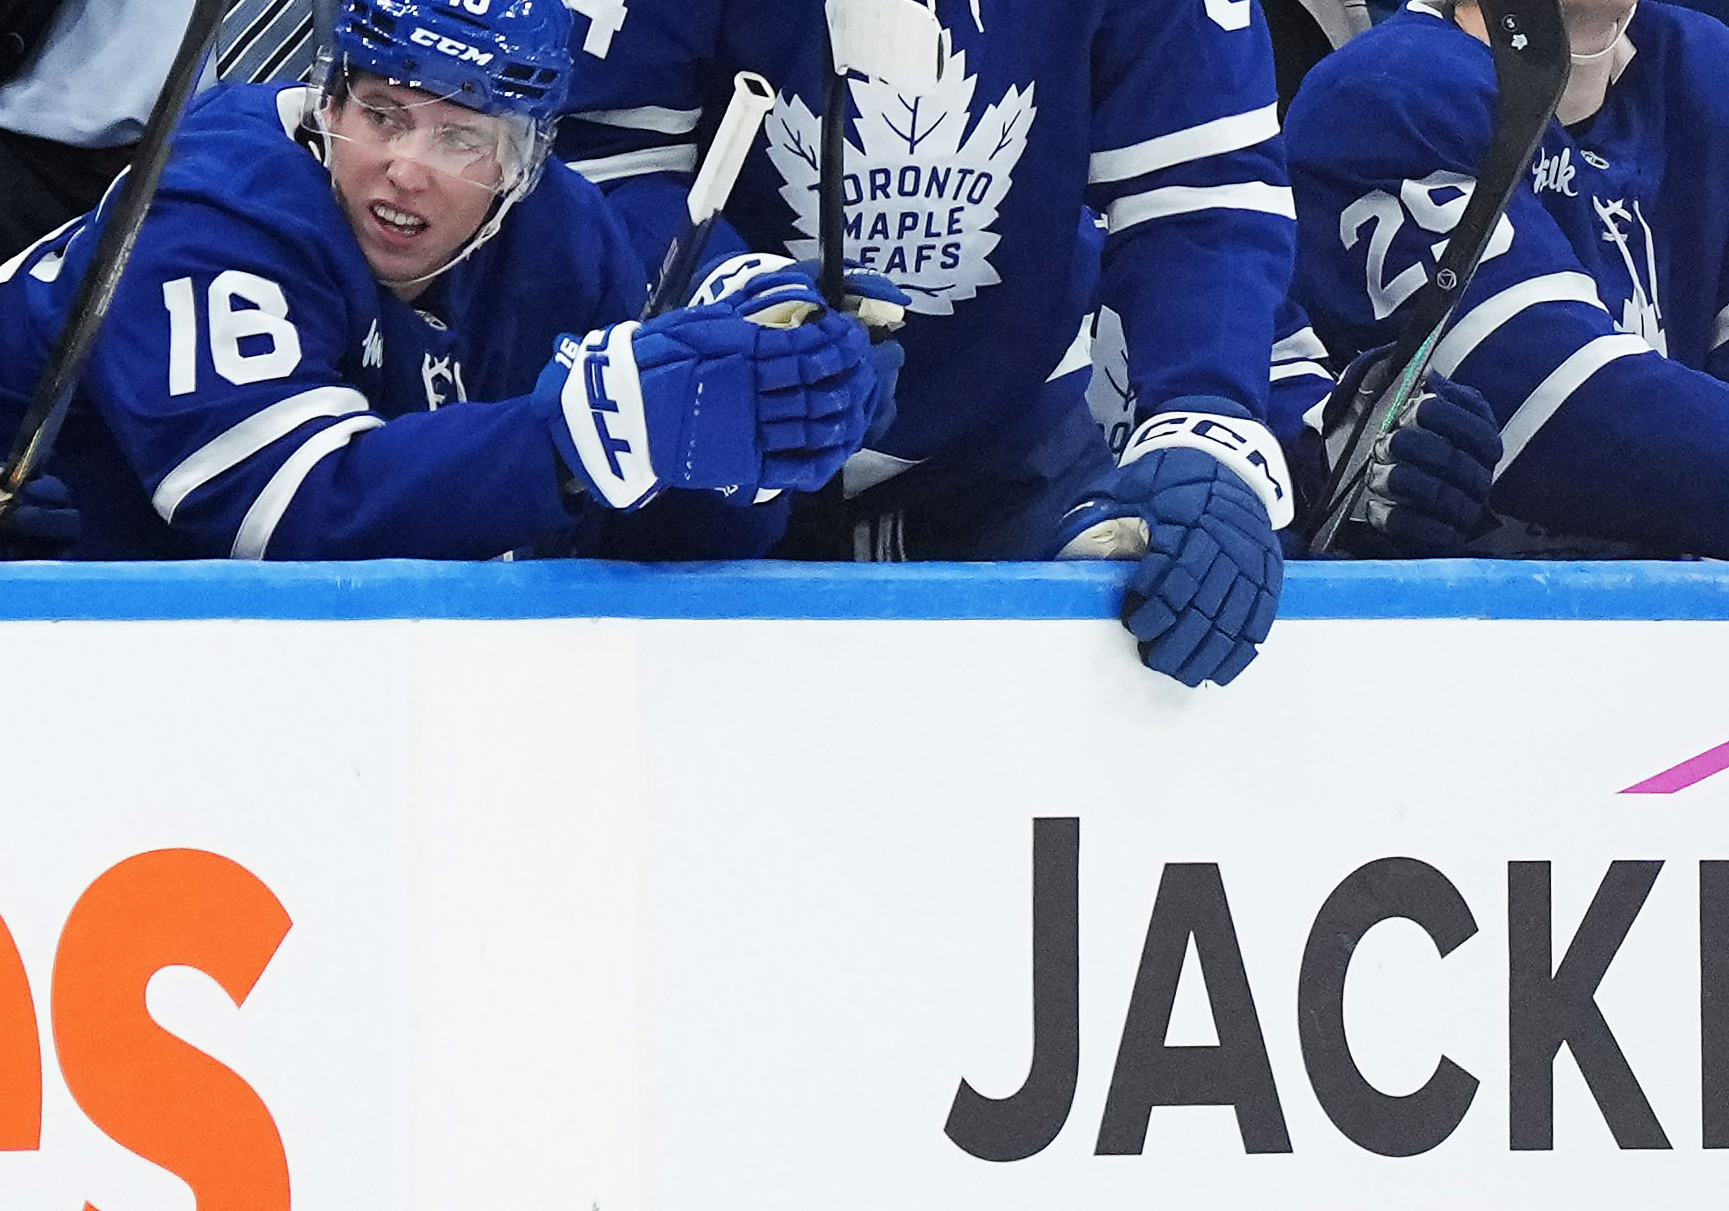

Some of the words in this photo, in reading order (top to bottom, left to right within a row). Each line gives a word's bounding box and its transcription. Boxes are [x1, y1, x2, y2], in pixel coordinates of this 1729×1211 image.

[410, 26, 495, 67] CCM
[806, 165, 994, 206] ORONTO
[859, 242, 963, 275] EAFS
[554, 337, 581, 370] 16
[1133, 416, 1284, 502] CCM
